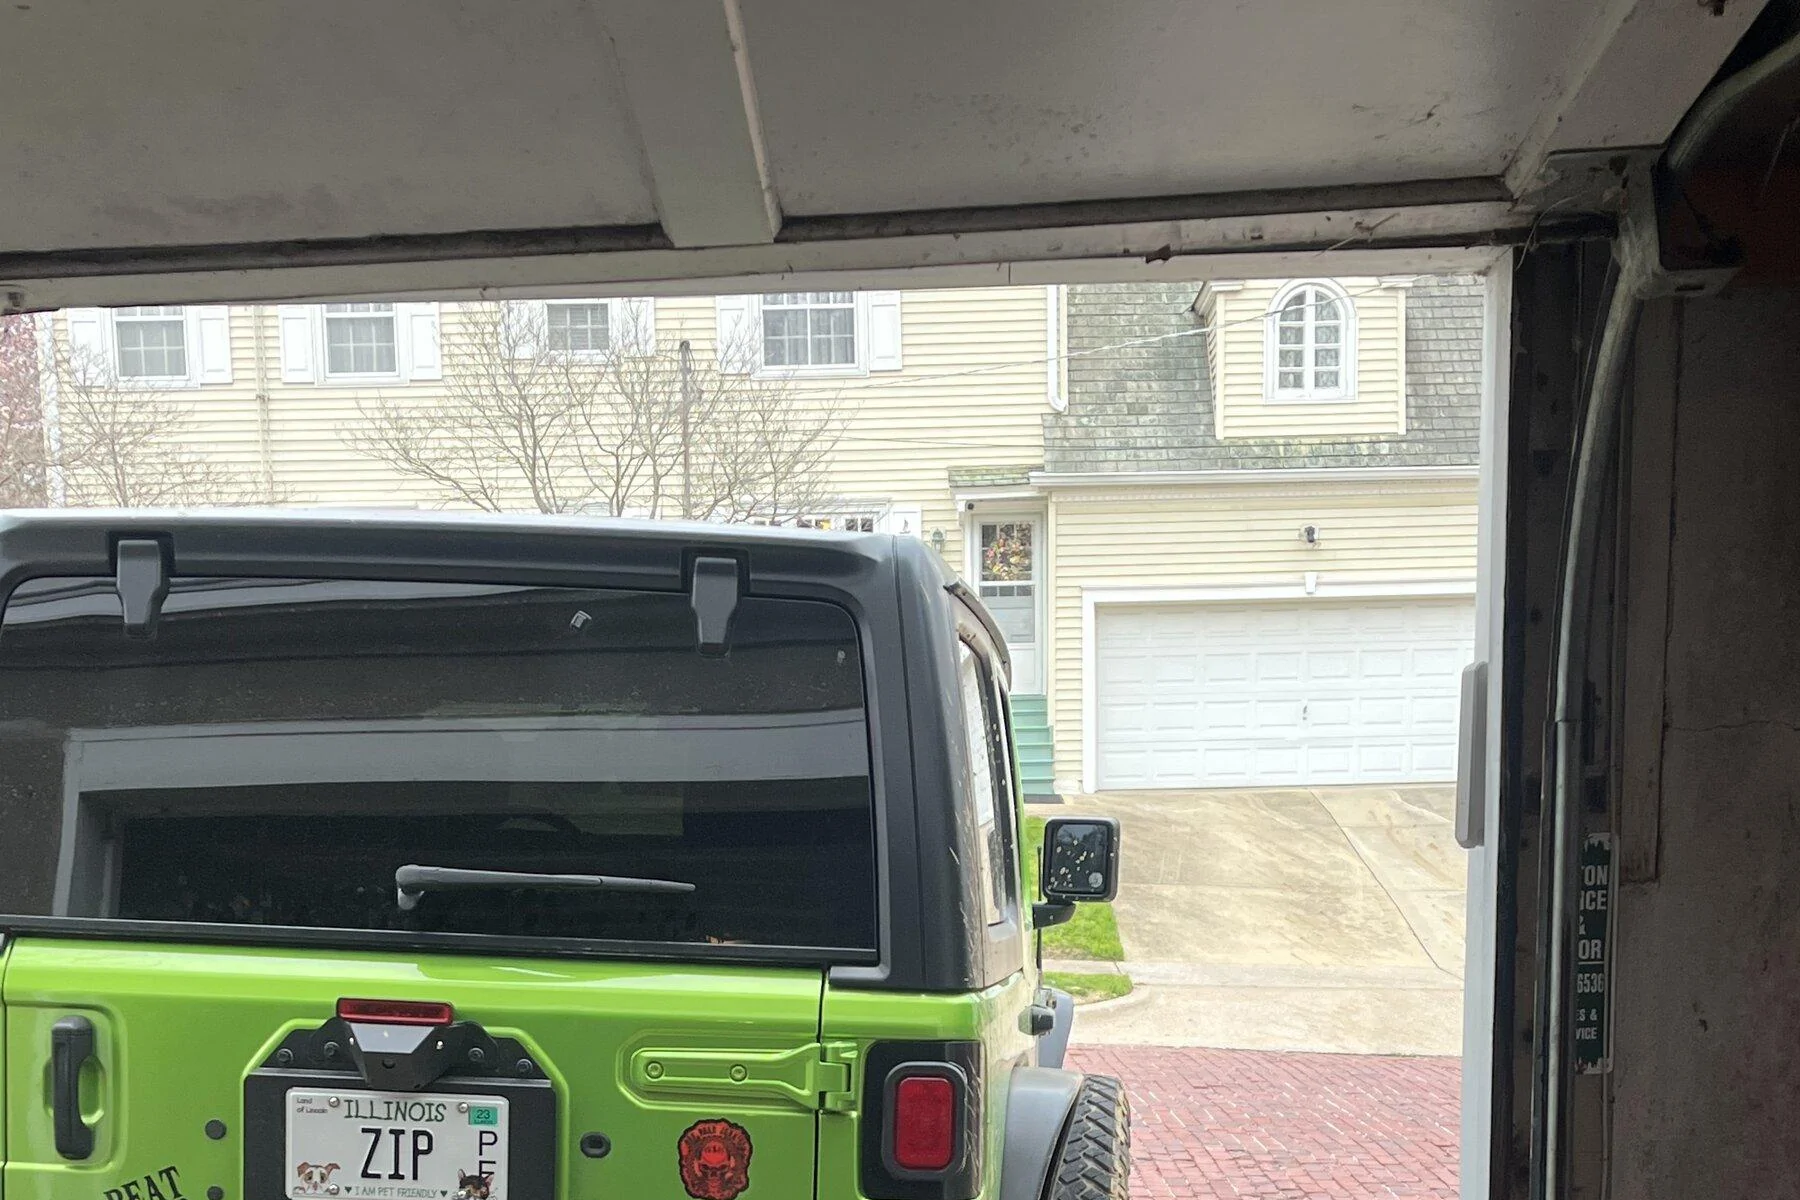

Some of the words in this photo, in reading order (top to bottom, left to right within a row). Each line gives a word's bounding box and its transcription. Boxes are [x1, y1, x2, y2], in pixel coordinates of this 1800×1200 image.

[1589, 1008, 1598, 1021] &
[343, 1099, 448, 1122] ILLINOIS
[476, 1109, 491, 1120] 23
[361, 1127, 434, 1181] ZIP
[361, 1186, 376, 1197] AM
[377, 1186, 395, 1197] PET
[397, 1187, 438, 1199] FRIENDLY
